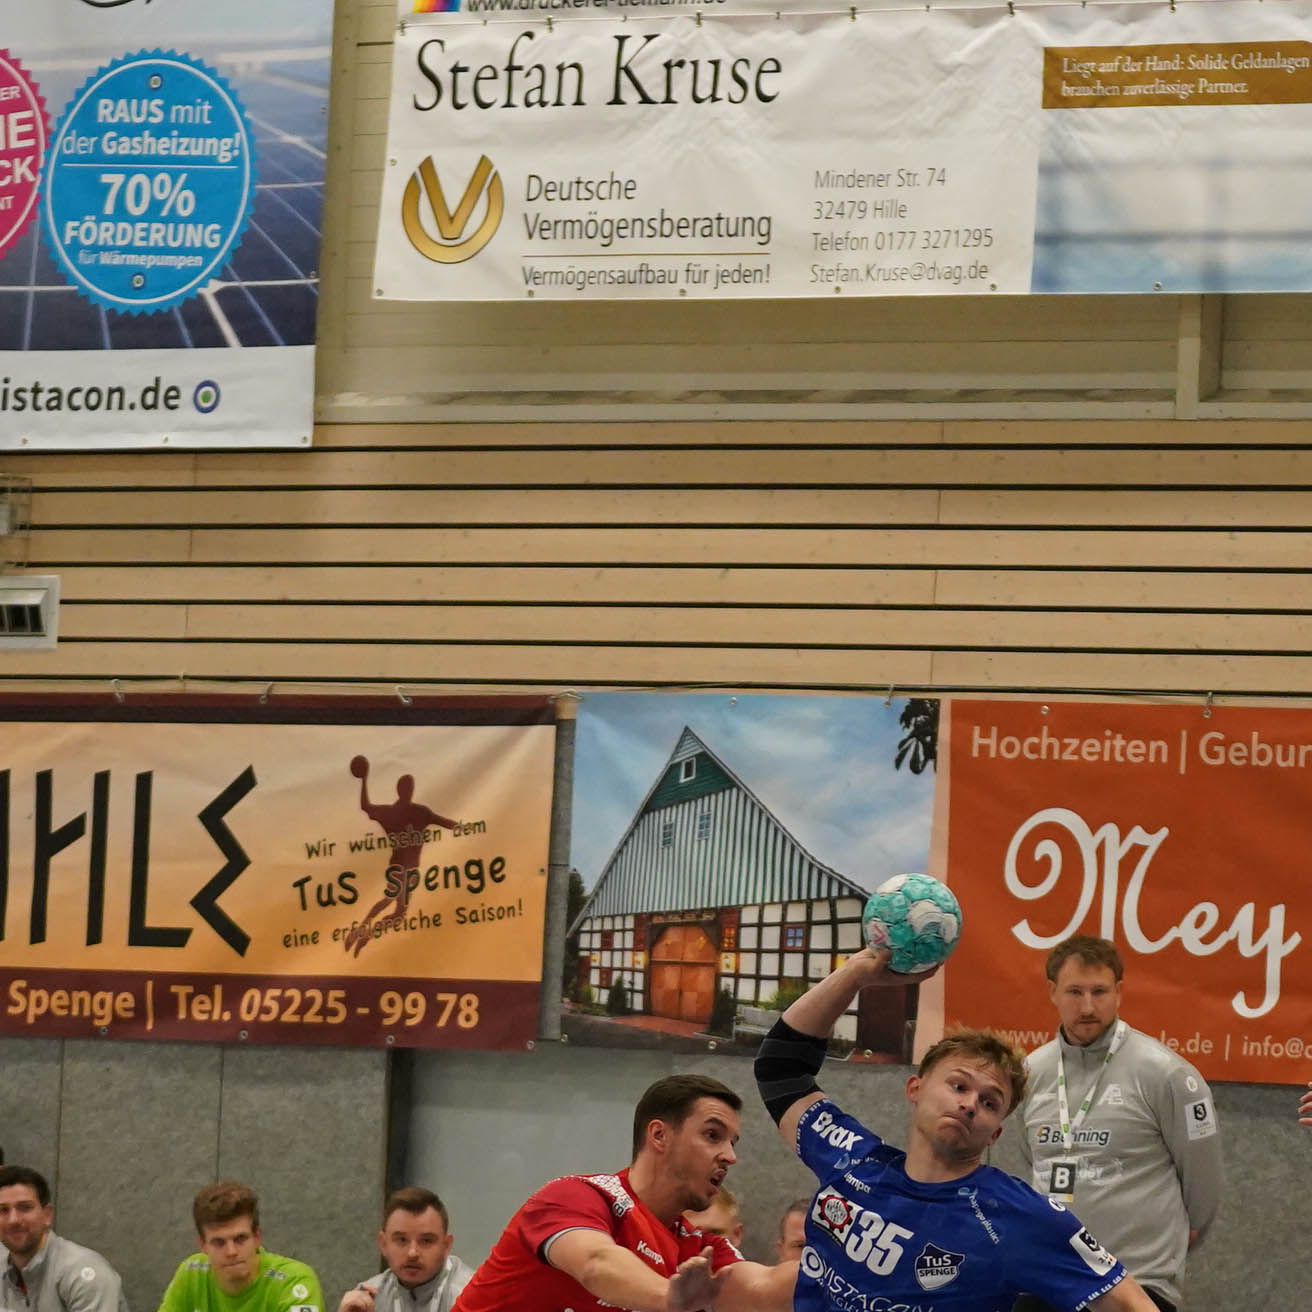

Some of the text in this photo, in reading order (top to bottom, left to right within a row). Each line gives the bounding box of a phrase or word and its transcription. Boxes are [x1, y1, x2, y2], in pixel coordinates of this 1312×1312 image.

[413, 31, 782, 112] Stefan Kruse
[1062, 52, 1310, 79] Liegt auf der Hand: Solide Geldanlagen
[1062, 79, 1120, 97] brauchen
[1123, 78, 1195, 99] zuverlässige
[97, 99, 213, 124] RAUS mit
[63, 130, 240, 163] der Gasheizung!
[526, 171, 637, 202] Deutsche
[815, 168, 946, 188] Mindener Str. 74
[100, 172, 196, 217] 70%
[813, 200, 908, 220] 32479 Hille
[65, 216, 222, 248] FÖRDERUNG
[523, 209, 772, 247] Vermögensberatung
[812, 228, 994, 251] Telefon 0177 3271295
[79, 250, 204, 269] für Wärmepumpen
[810, 260, 989, 286] Stefan.Kruse@dvag.de
[522, 263, 771, 290] Vermögensaufbau für jeden!
[971, 725, 1168, 763] Hochzeiten
[305, 818, 486, 859] Wir wünschen dem
[292, 856, 507, 911] TuS Spenge
[282, 930, 320, 948] eine
[455, 899, 524, 925] Saison!
[7, 979, 135, 1027] Spenge
[171, 984, 231, 1022] Tel.
[240, 988, 347, 1025] 05225
[379, 992, 427, 1027] 99
[435, 992, 480, 1029] 78
[843, 1208, 914, 1276] 35
[919, 1265, 956, 1277] SPENGE
[923, 1253, 952, 1267] TuS
